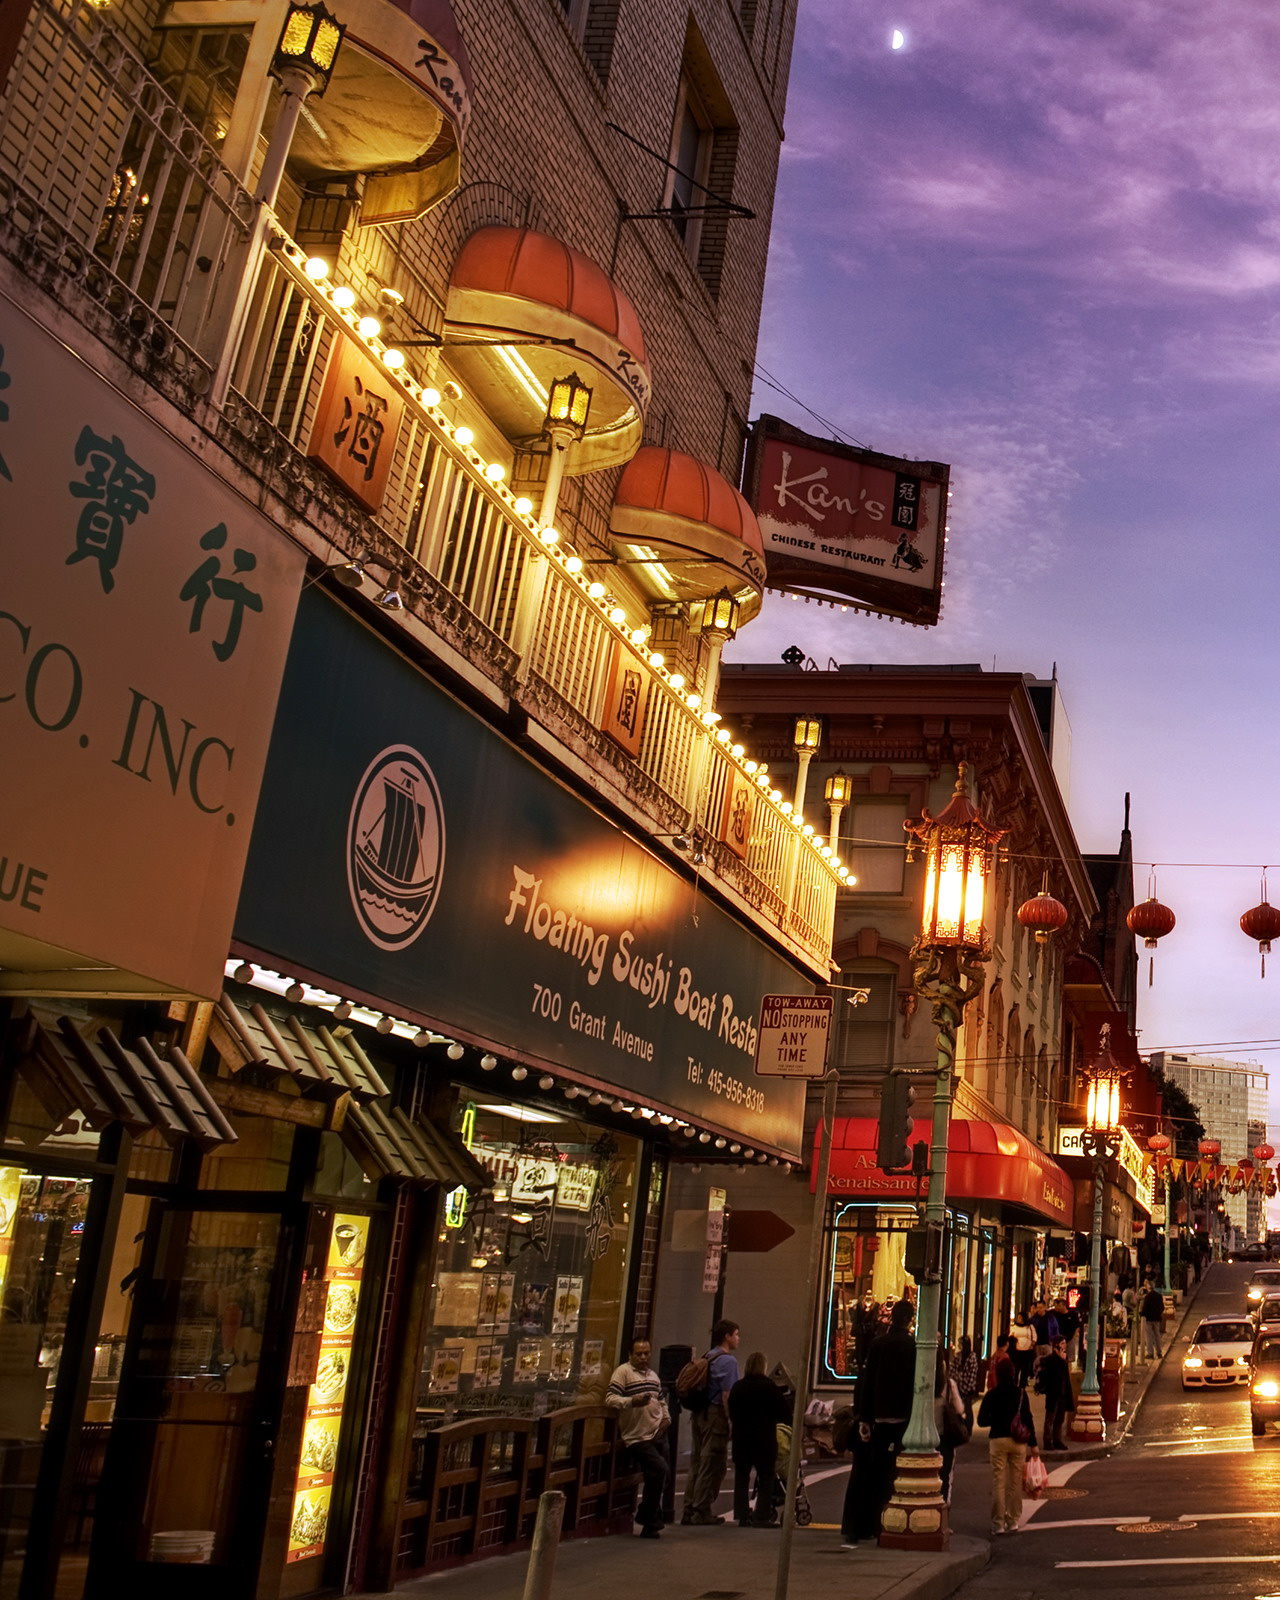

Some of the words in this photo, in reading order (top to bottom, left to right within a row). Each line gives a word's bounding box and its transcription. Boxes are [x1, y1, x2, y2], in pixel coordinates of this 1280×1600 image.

[334, 376, 388, 481] 酒
[773, 451, 885, 521] Kan's
[772, 533, 815, 551] CHINESE
[820, 544, 886, 567] RESTAURANT
[111, 687, 235, 827] INC.
[504, 864, 609, 986] Floating
[612, 930, 674, 1009] Sushi
[674, 966, 717, 1031] Boat
[718, 994, 758, 1057] Resta
[531, 983, 562, 1022] 700
[569, 1001, 607, 1041] Grant
[612, 1020, 655, 1062] Avenue
[762, 1009, 781, 1028] NO
[782, 1013, 827, 1029] STOPPING
[768, 997, 828, 1009] TOW-AWAY
[777, 1048, 807, 1062] TIME
[780, 1032, 807, 1046] ANY
[687, 1056, 703, 1085] Tel:
[707, 1069, 764, 1115] 415-956-8318
